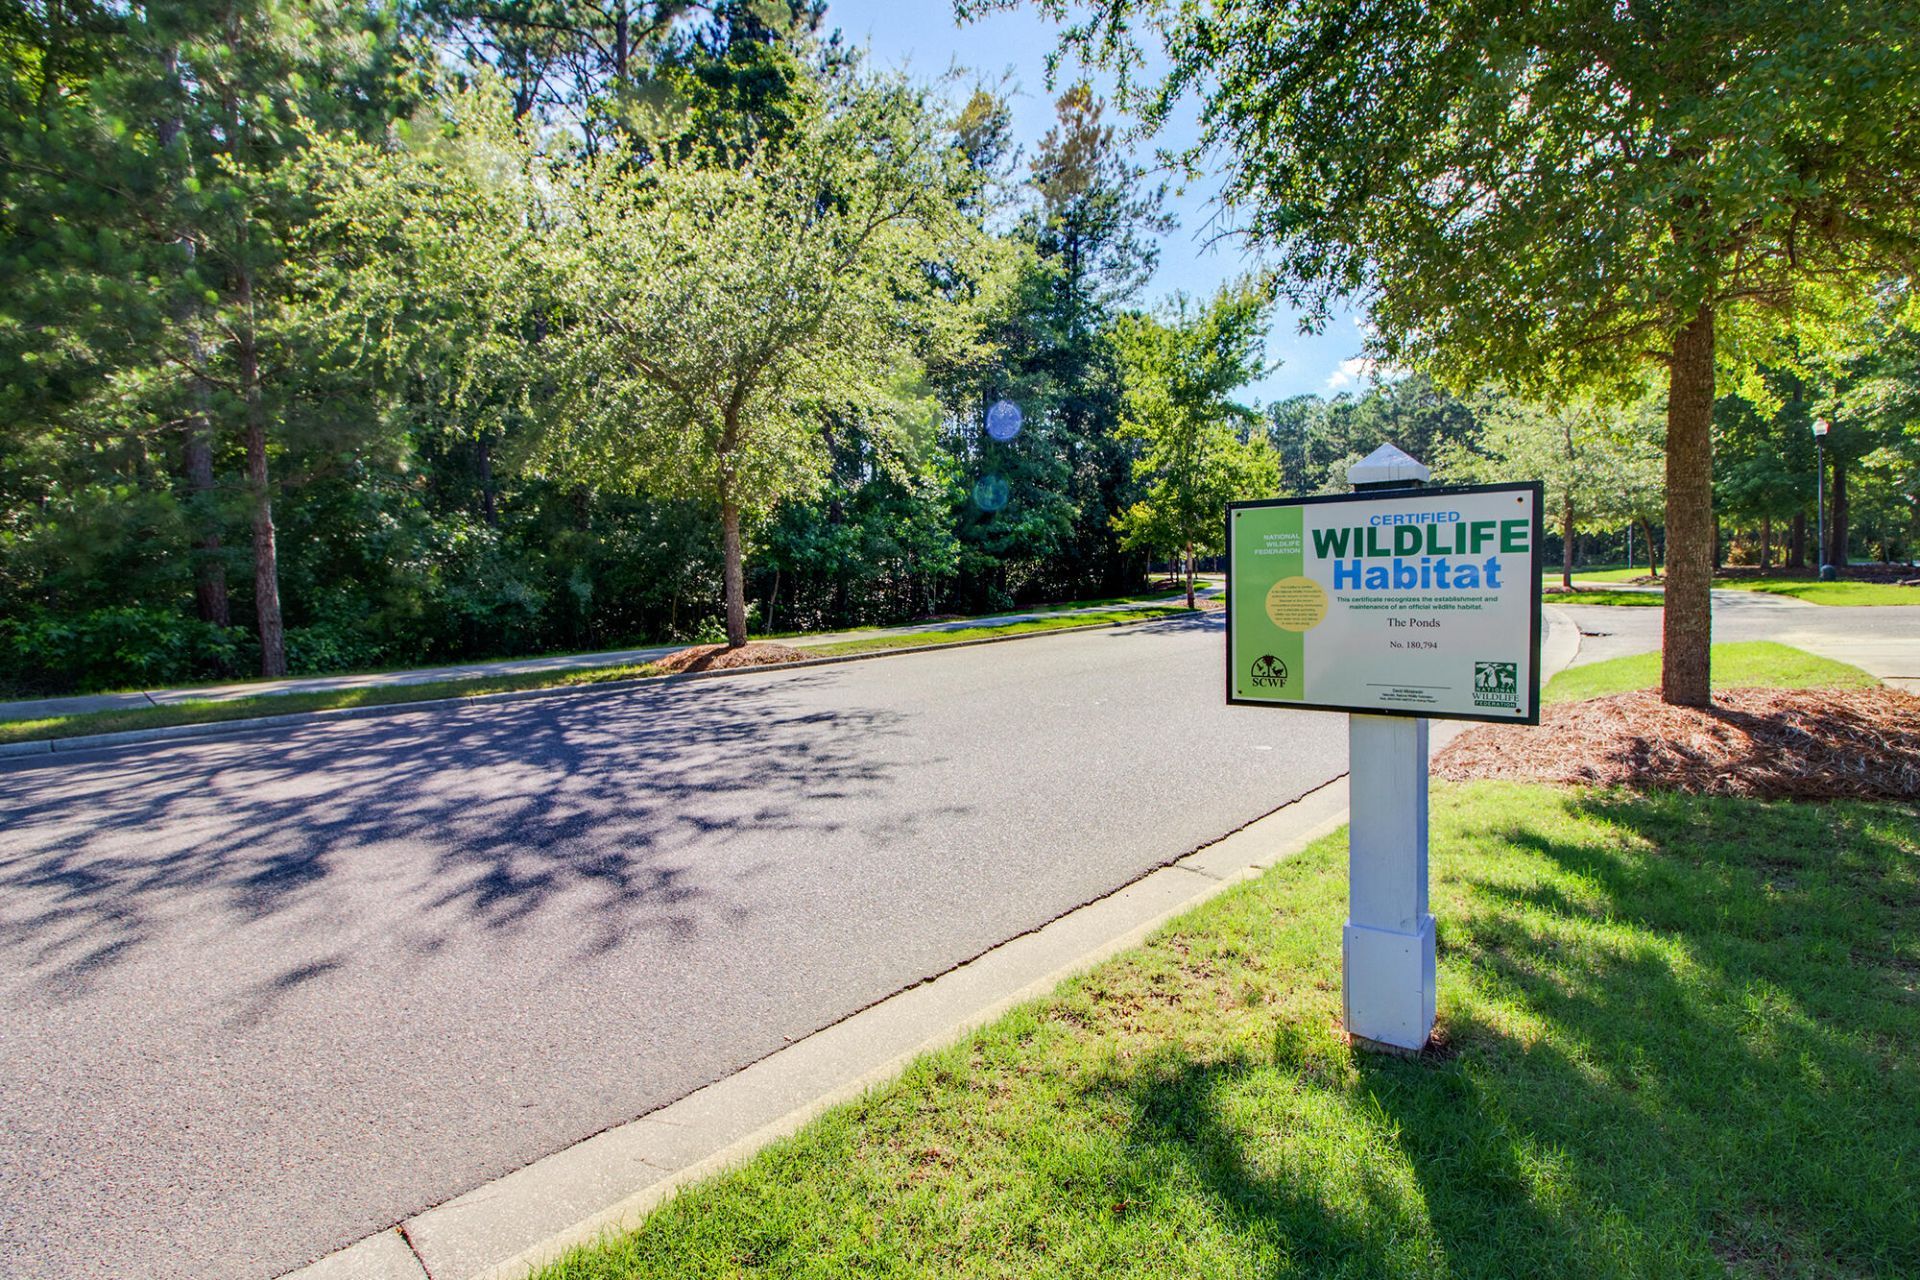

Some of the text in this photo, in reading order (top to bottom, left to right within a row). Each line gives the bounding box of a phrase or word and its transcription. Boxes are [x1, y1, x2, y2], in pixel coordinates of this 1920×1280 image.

[1370, 511, 1460, 526] CERTIFIED
[1312, 519, 1530, 559] WILDLIFE
[1333, 555, 1502, 590] Habitat
[1384, 596, 1420, 604] recognizes
[1387, 617, 1441, 628] The Ponds
[1390, 641, 1438, 650] No. 180,794
[1252, 677, 1287, 688] SCWF
[1472, 692, 1520, 702] WILDLIFE
